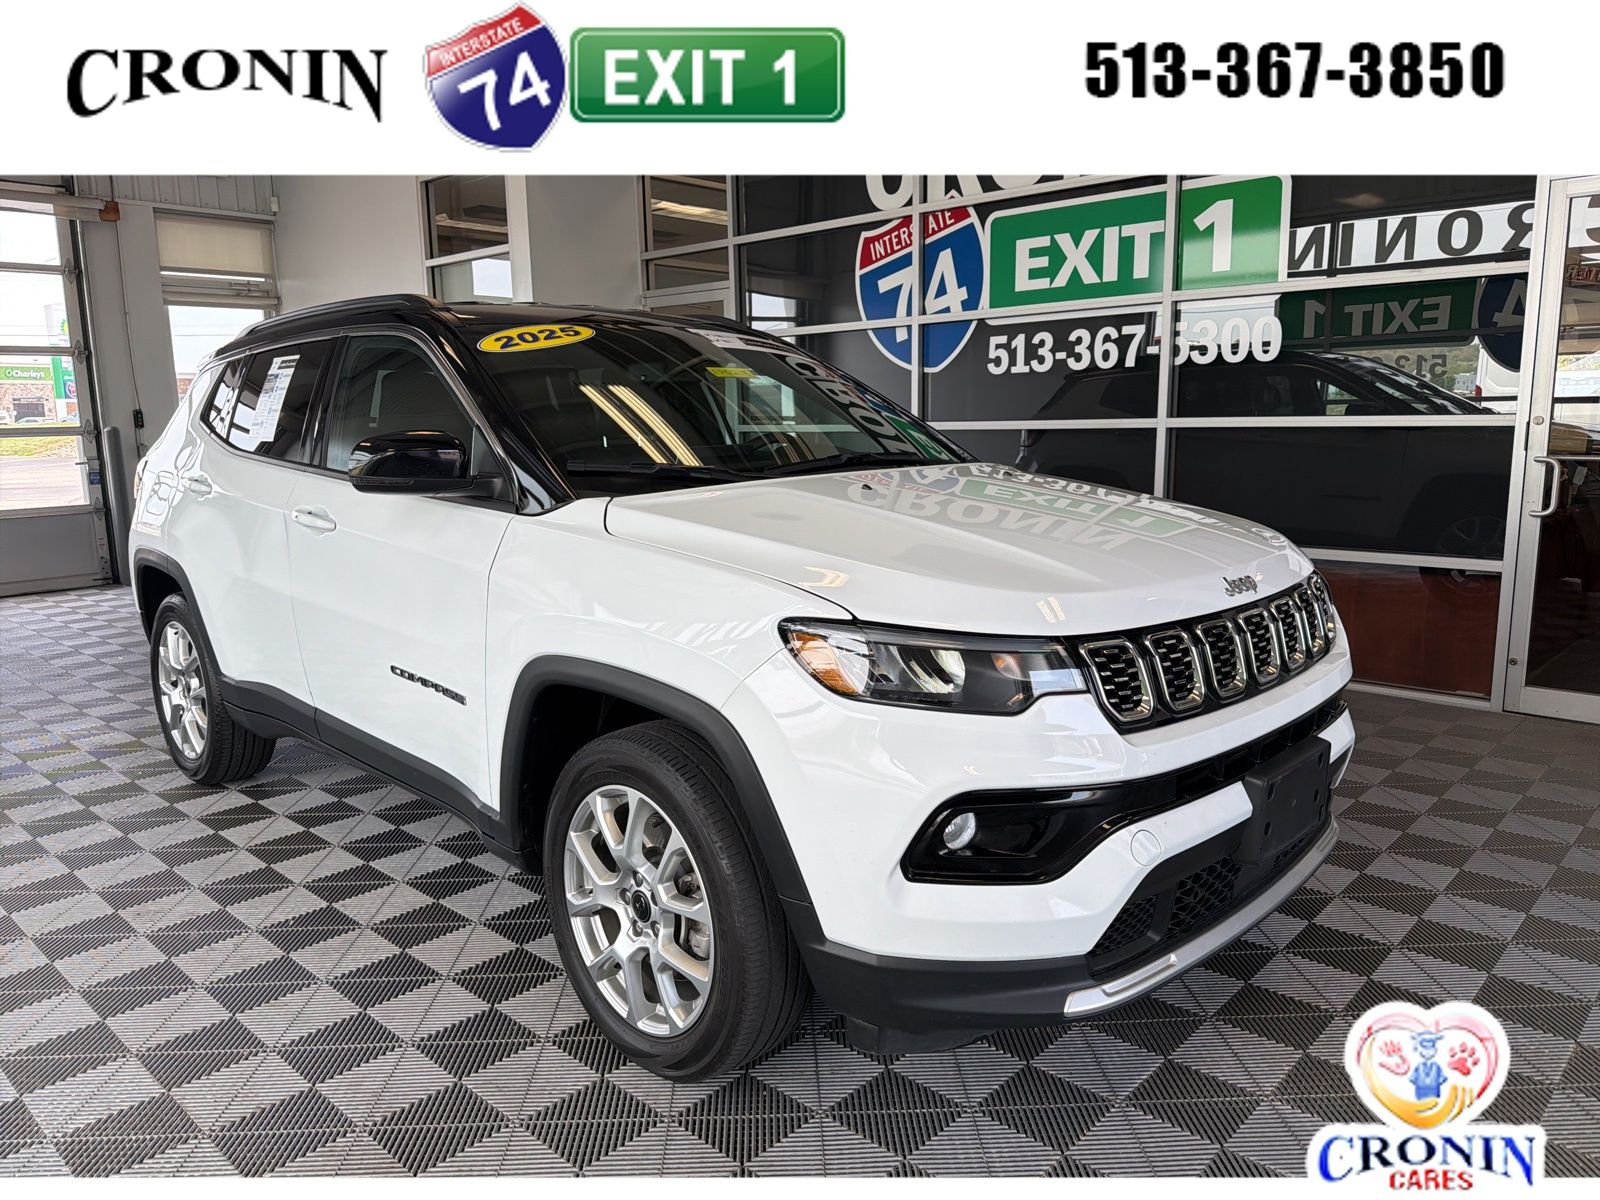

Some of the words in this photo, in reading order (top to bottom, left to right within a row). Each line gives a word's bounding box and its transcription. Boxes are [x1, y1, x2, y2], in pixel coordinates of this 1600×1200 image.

[870, 210, 955, 261] INTERATE
[1014, 220, 1165, 292] EXIT
[1193, 199, 1233, 272] 1
[878, 248, 969, 342] 74
[494, 326, 583, 350] 2025
[986, 315, 1283, 375] 513-367-5300
[1221, 575, 1257, 597] Jeep
[390, 665, 467, 706] COMPASS
